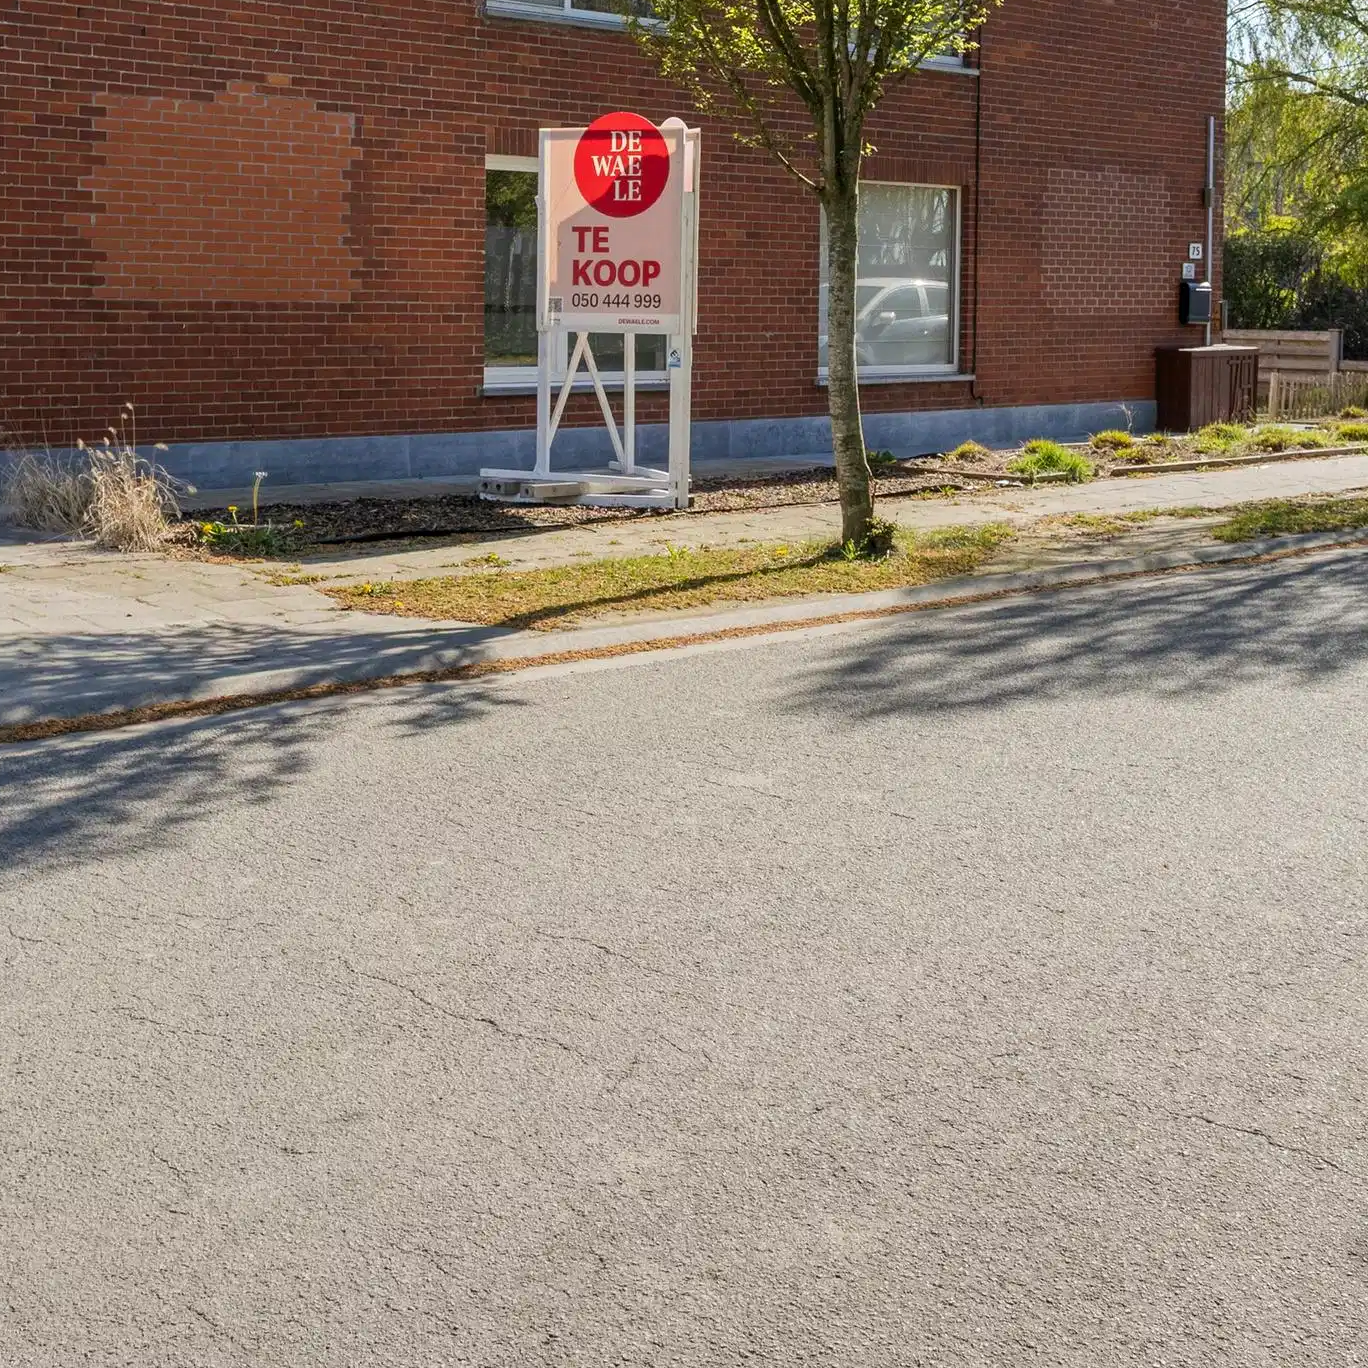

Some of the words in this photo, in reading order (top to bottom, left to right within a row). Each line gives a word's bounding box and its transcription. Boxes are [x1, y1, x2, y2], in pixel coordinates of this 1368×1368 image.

[610, 130, 643, 153] DE
[591, 155, 643, 177] WAE
[613, 179, 643, 201] LE
[571, 226, 610, 253] TE
[1192, 246, 1201, 256] 75
[572, 259, 661, 287] KOOP
[572, 293, 599, 308] 050
[602, 293, 631, 308] 444
[633, 294, 662, 309] 999
